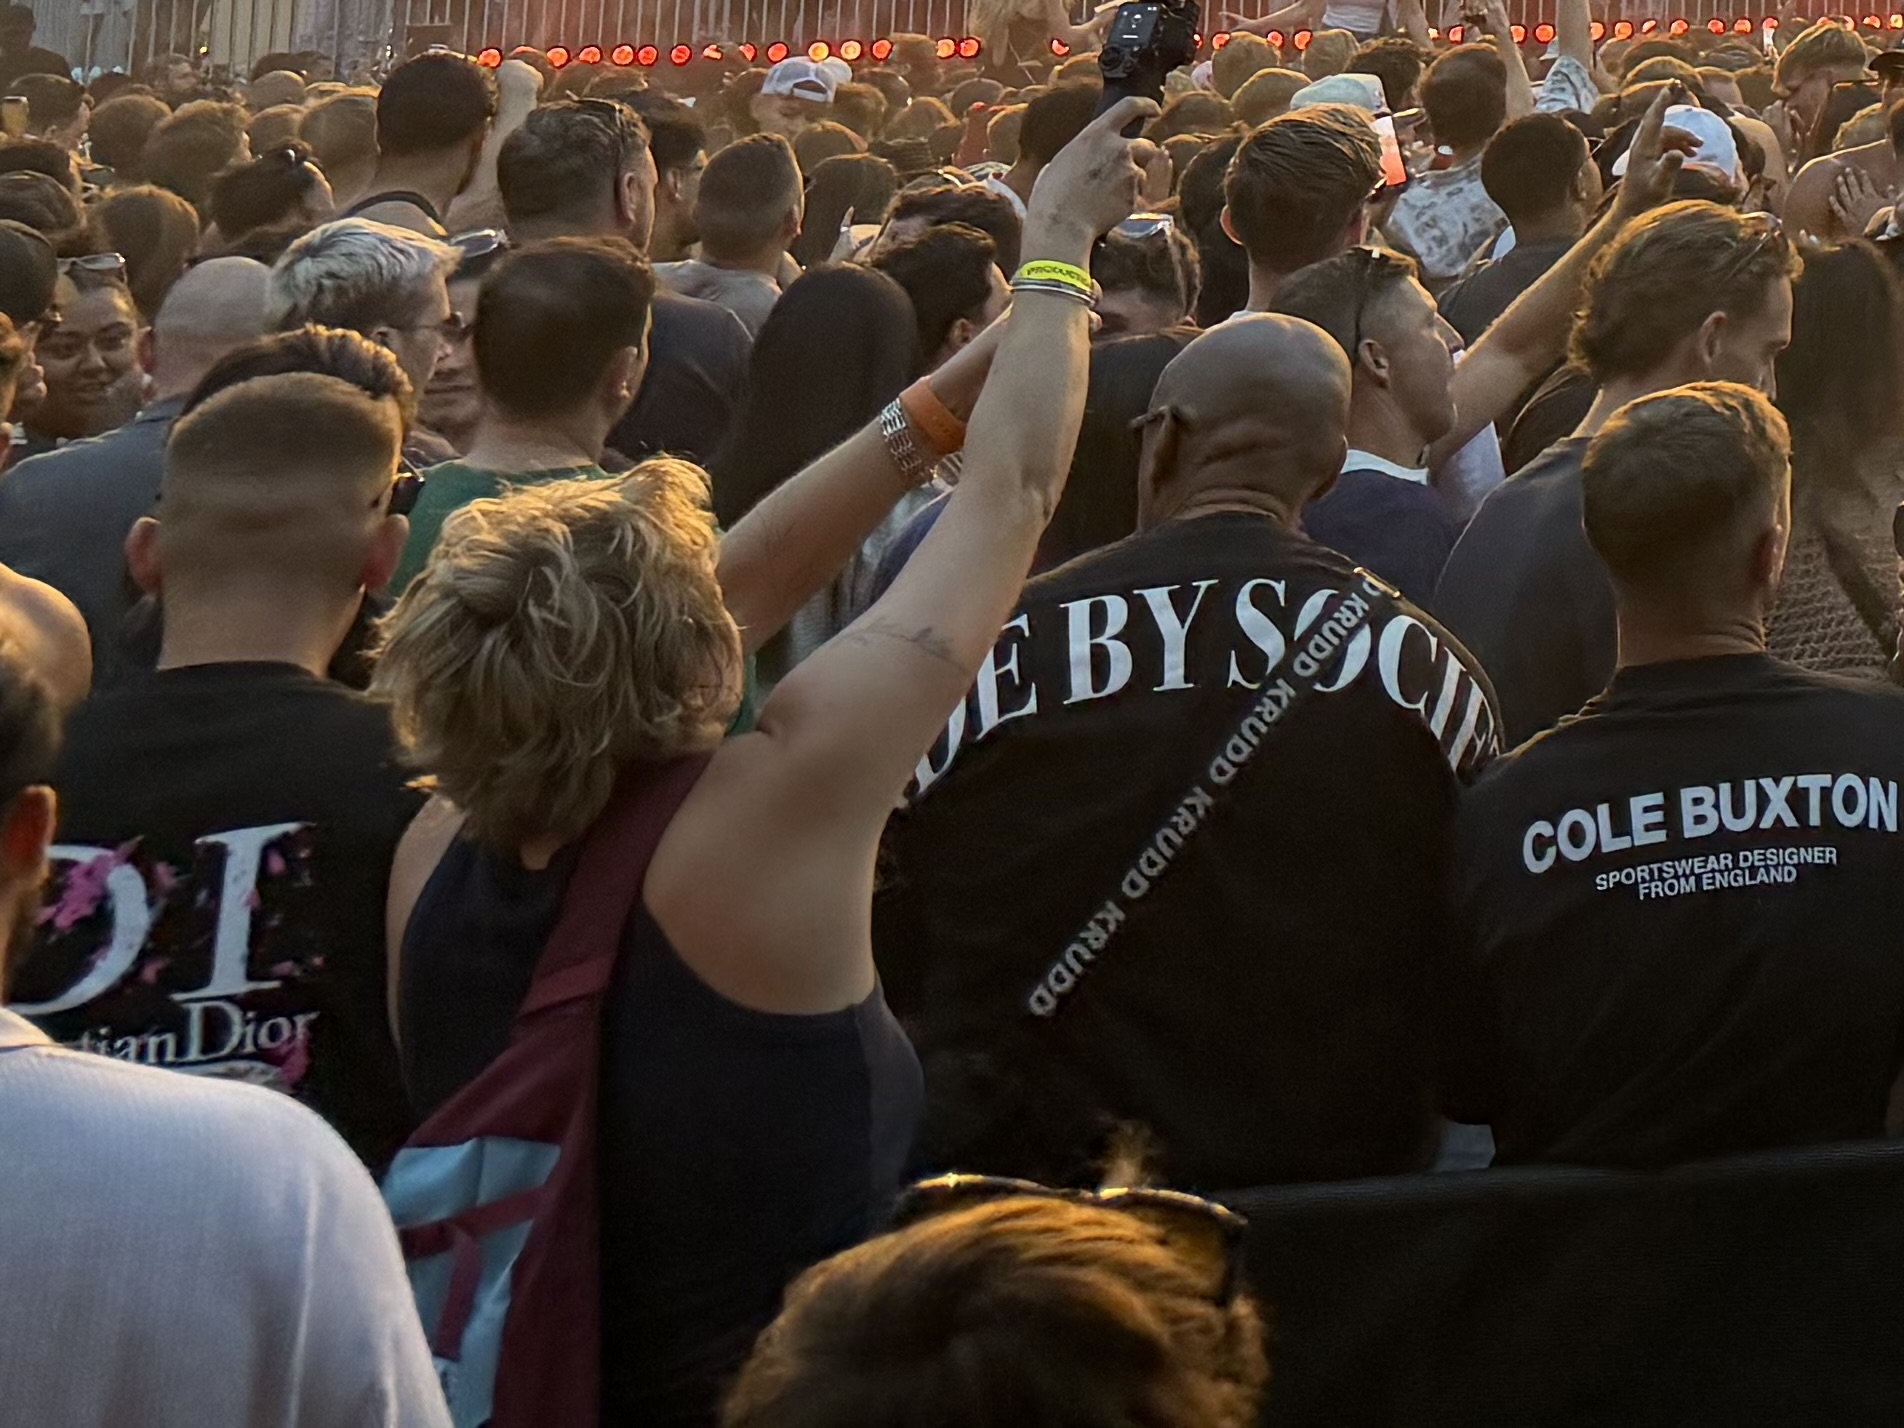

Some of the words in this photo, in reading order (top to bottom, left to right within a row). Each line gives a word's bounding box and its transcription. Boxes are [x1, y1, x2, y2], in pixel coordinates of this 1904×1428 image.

[1059, 579, 1218, 706] BY
[1293, 592, 1369, 677] KRUDD
[1209, 678, 1296, 785] KRUDD
[1121, 786, 1213, 899] KRUDD
[1522, 792, 1668, 874] COLE
[1680, 773, 1898, 839] BUXTON
[1596, 853, 1733, 891] SPORTSWEAR
[1739, 847, 1838, 869] DESIGNER
[1639, 879, 1696, 900] FROM
[1702, 867, 1797, 891] ENGLAND
[1029, 900, 1125, 1017] KRUDD
[178, 999, 320, 1062] Dior
